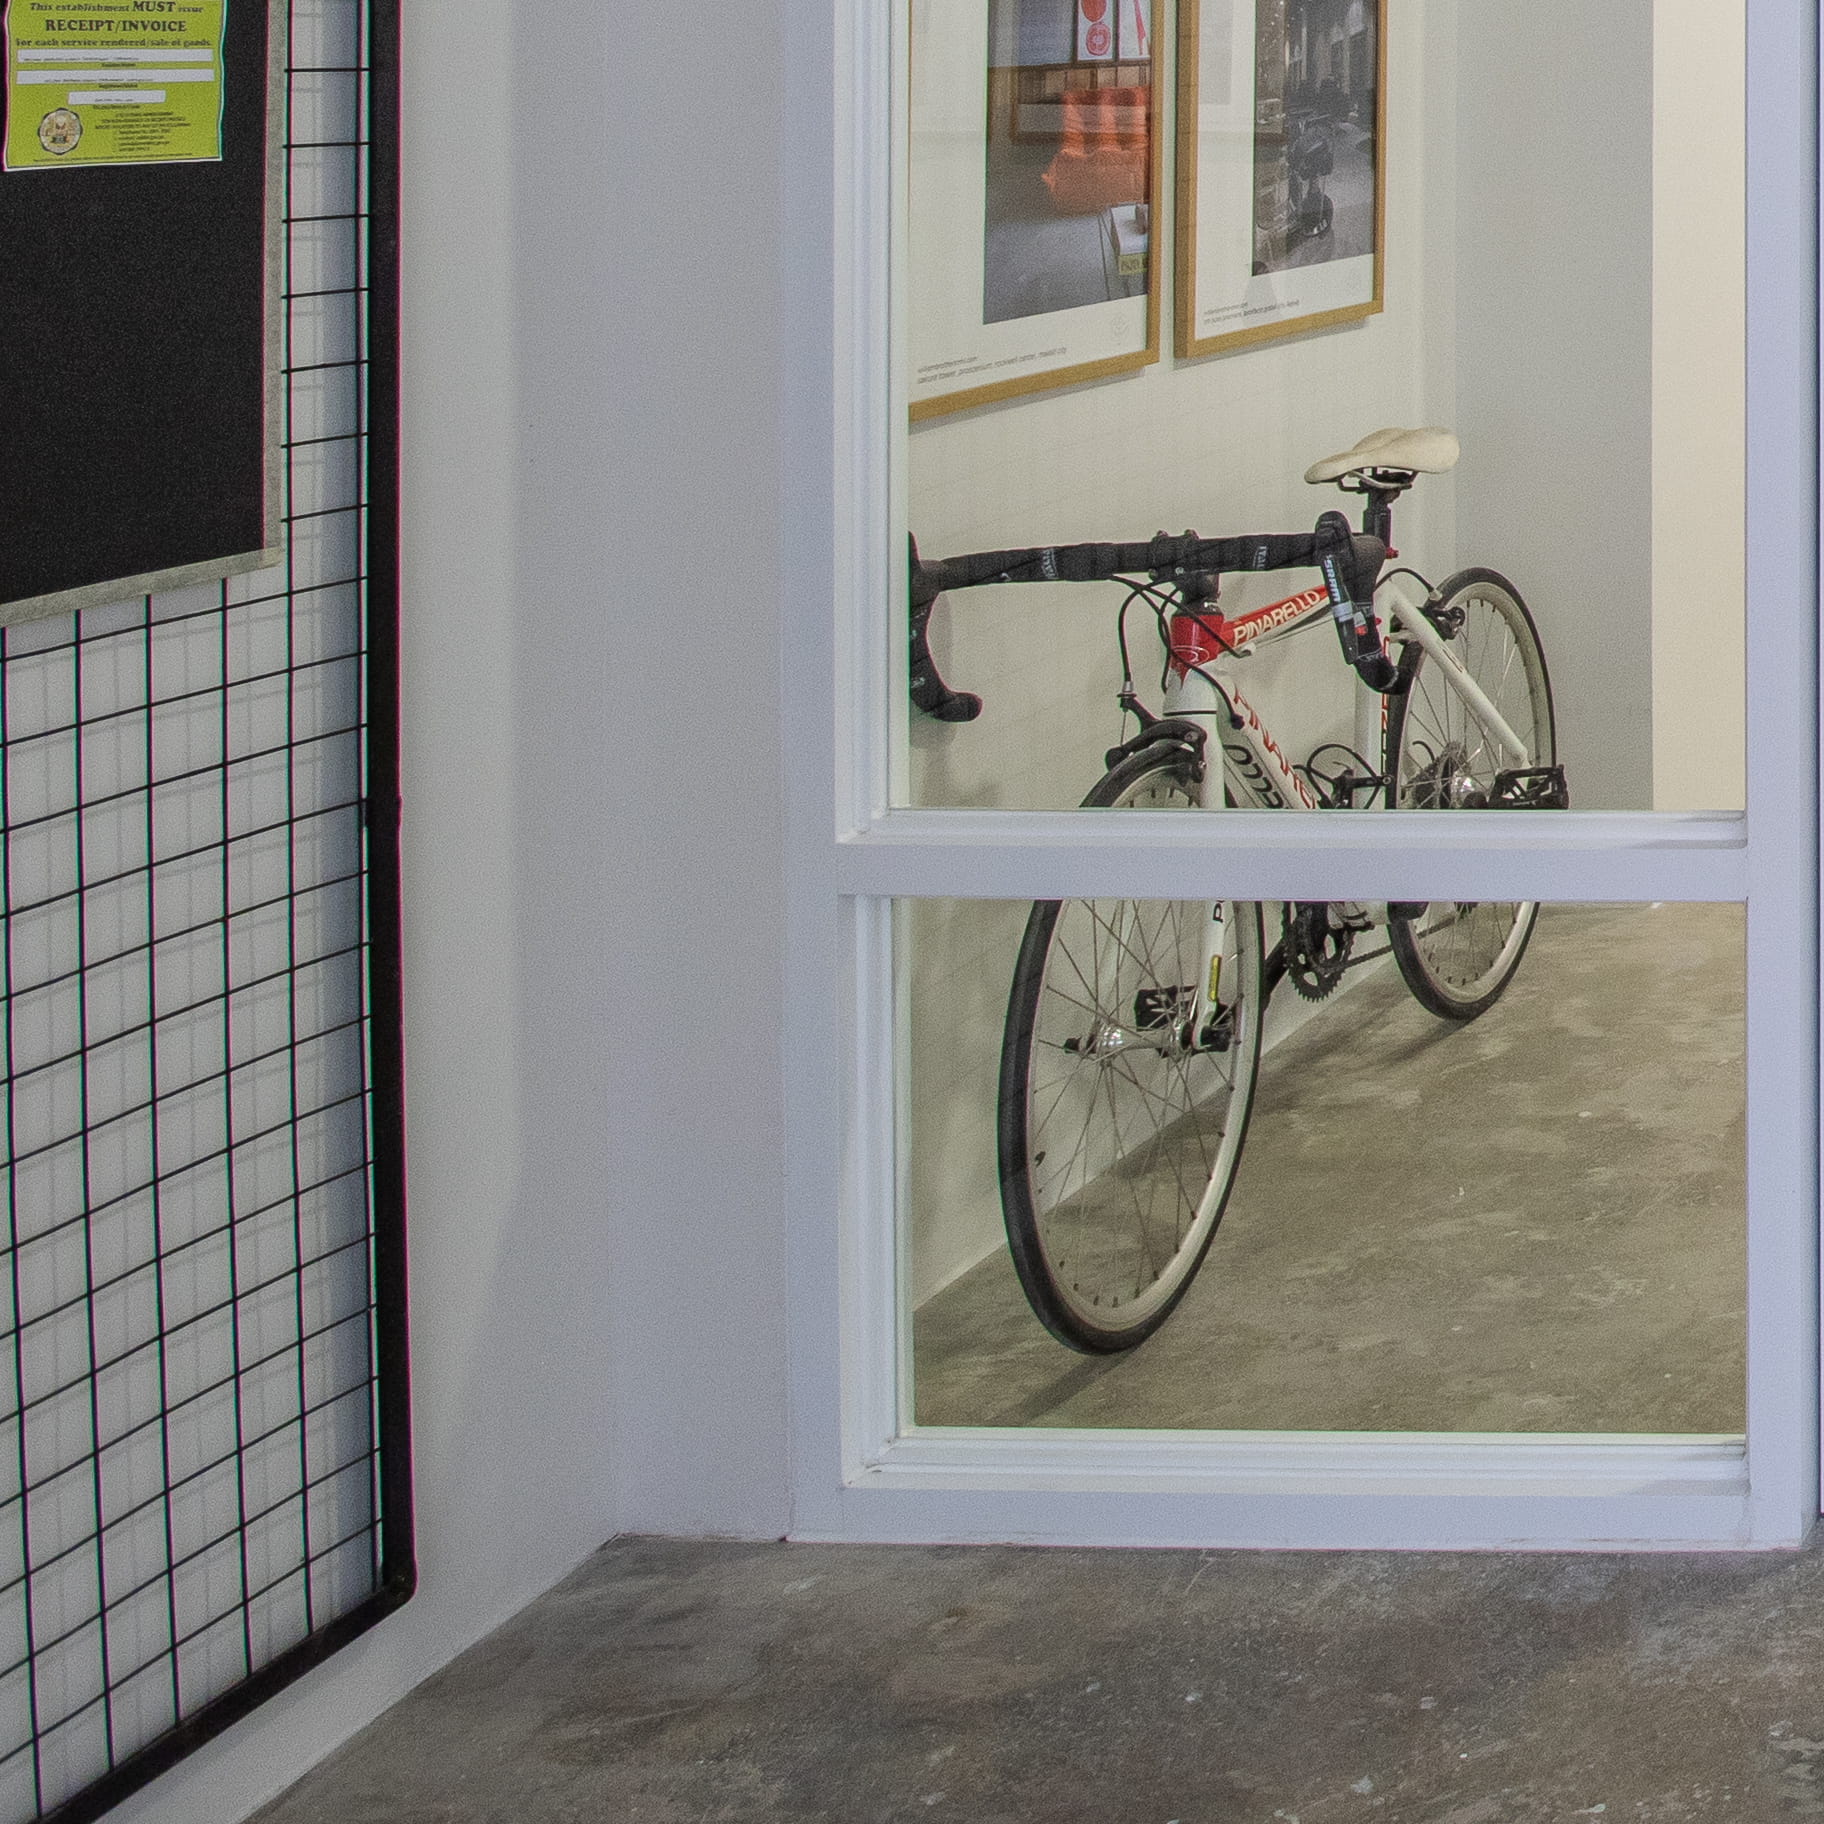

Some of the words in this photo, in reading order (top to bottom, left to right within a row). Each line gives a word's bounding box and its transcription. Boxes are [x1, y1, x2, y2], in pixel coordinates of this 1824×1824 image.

[30, 2, 53, 11] This
[55, 2, 131, 12] establishment
[131, 0, 176, 12] MUST
[45, 19, 187, 33] RECEIPT/INVOICE
[1324, 558, 1341, 602] SRAM
[1232, 589, 1320, 646] PINARELLO
